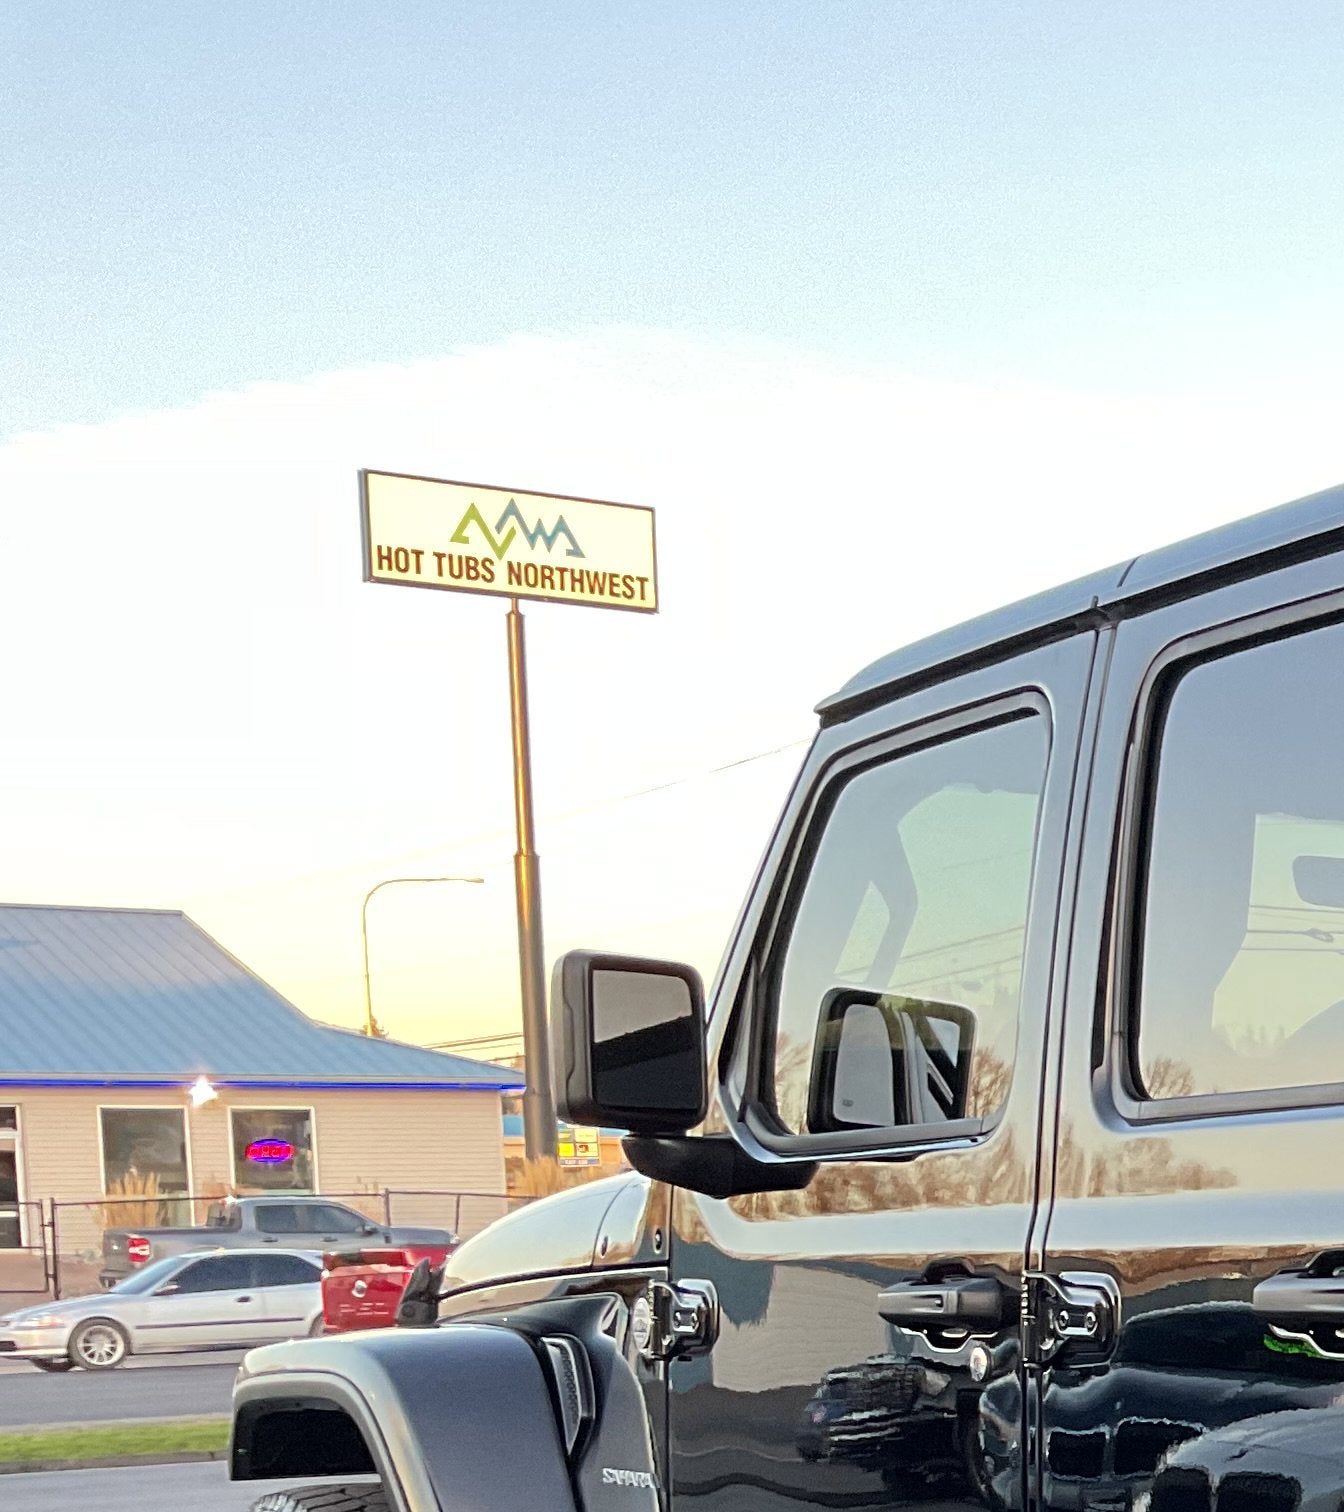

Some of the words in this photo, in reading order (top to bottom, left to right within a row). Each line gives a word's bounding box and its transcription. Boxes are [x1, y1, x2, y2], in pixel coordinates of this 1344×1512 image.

[377, 545, 424, 574] HOT
[432, 552, 495, 583] TUBS
[507, 561, 649, 601] NORTHWEST
[602, 1467, 656, 1489] SAHARA
